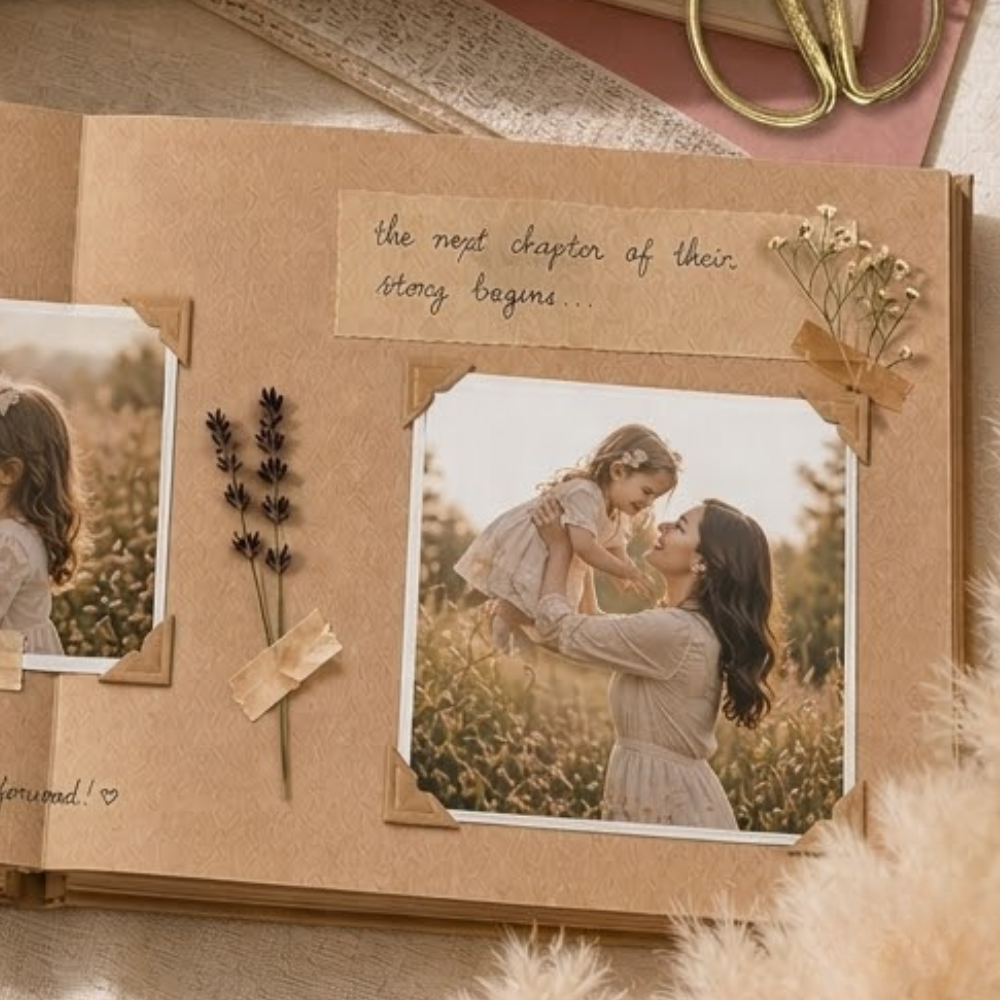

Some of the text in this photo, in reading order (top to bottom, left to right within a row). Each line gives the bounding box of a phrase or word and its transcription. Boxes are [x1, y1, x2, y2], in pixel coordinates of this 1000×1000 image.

[375, 214, 413, 247] the
[432, 228, 488, 263] next
[625, 238, 654, 277] of
